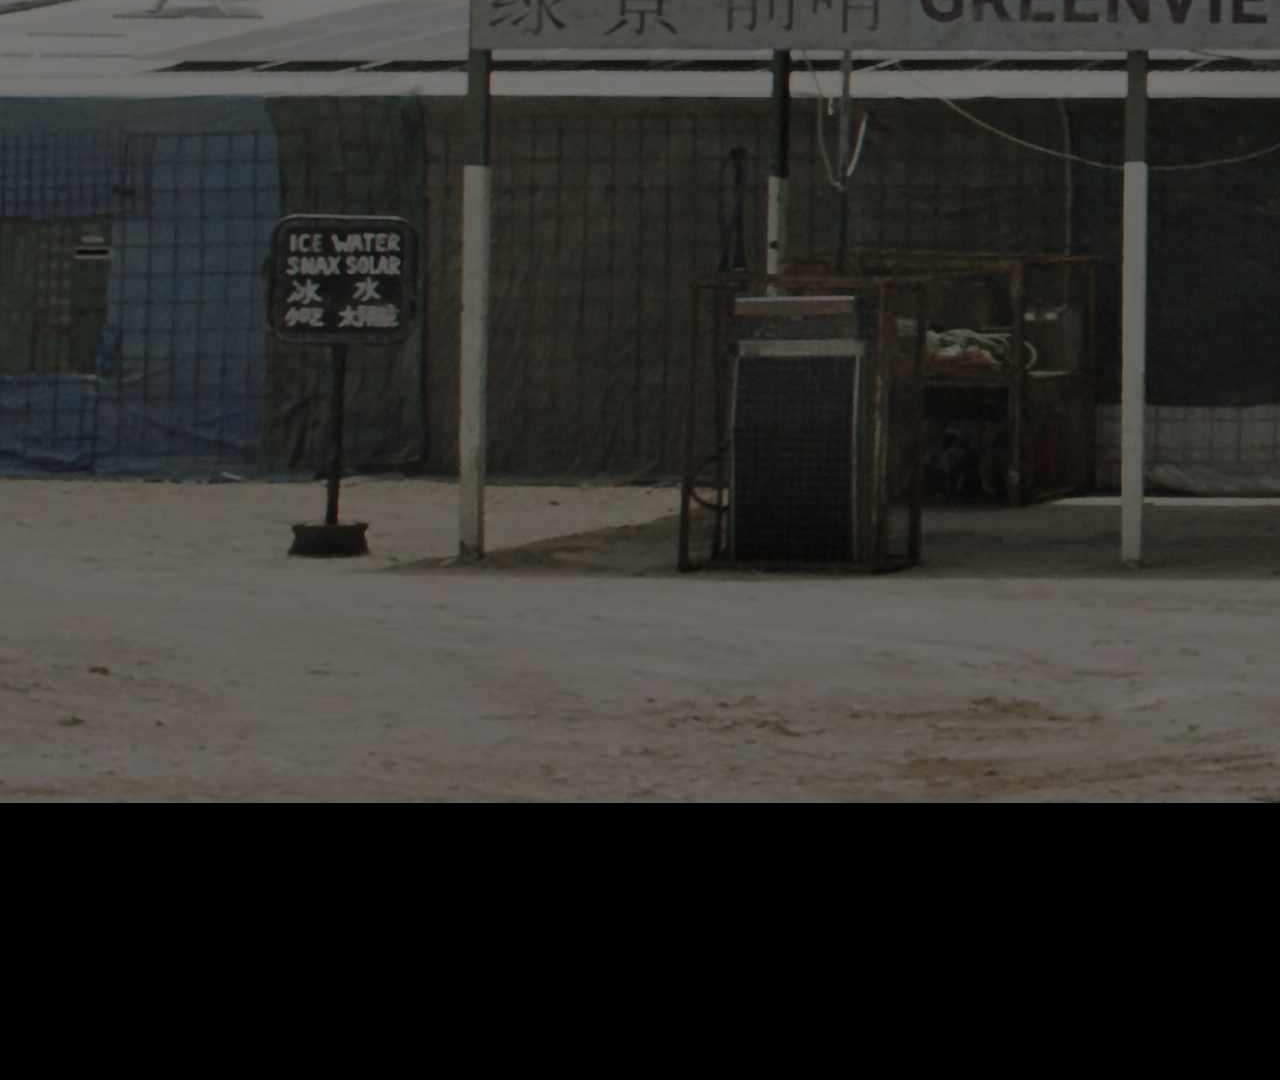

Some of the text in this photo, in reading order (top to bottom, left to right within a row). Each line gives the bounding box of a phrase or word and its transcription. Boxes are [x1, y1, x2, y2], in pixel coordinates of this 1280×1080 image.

[290, 232, 401, 252] ICE WATER
[286, 256, 402, 275] SNAX SOLAR
[352, 277, 381, 302] 水
